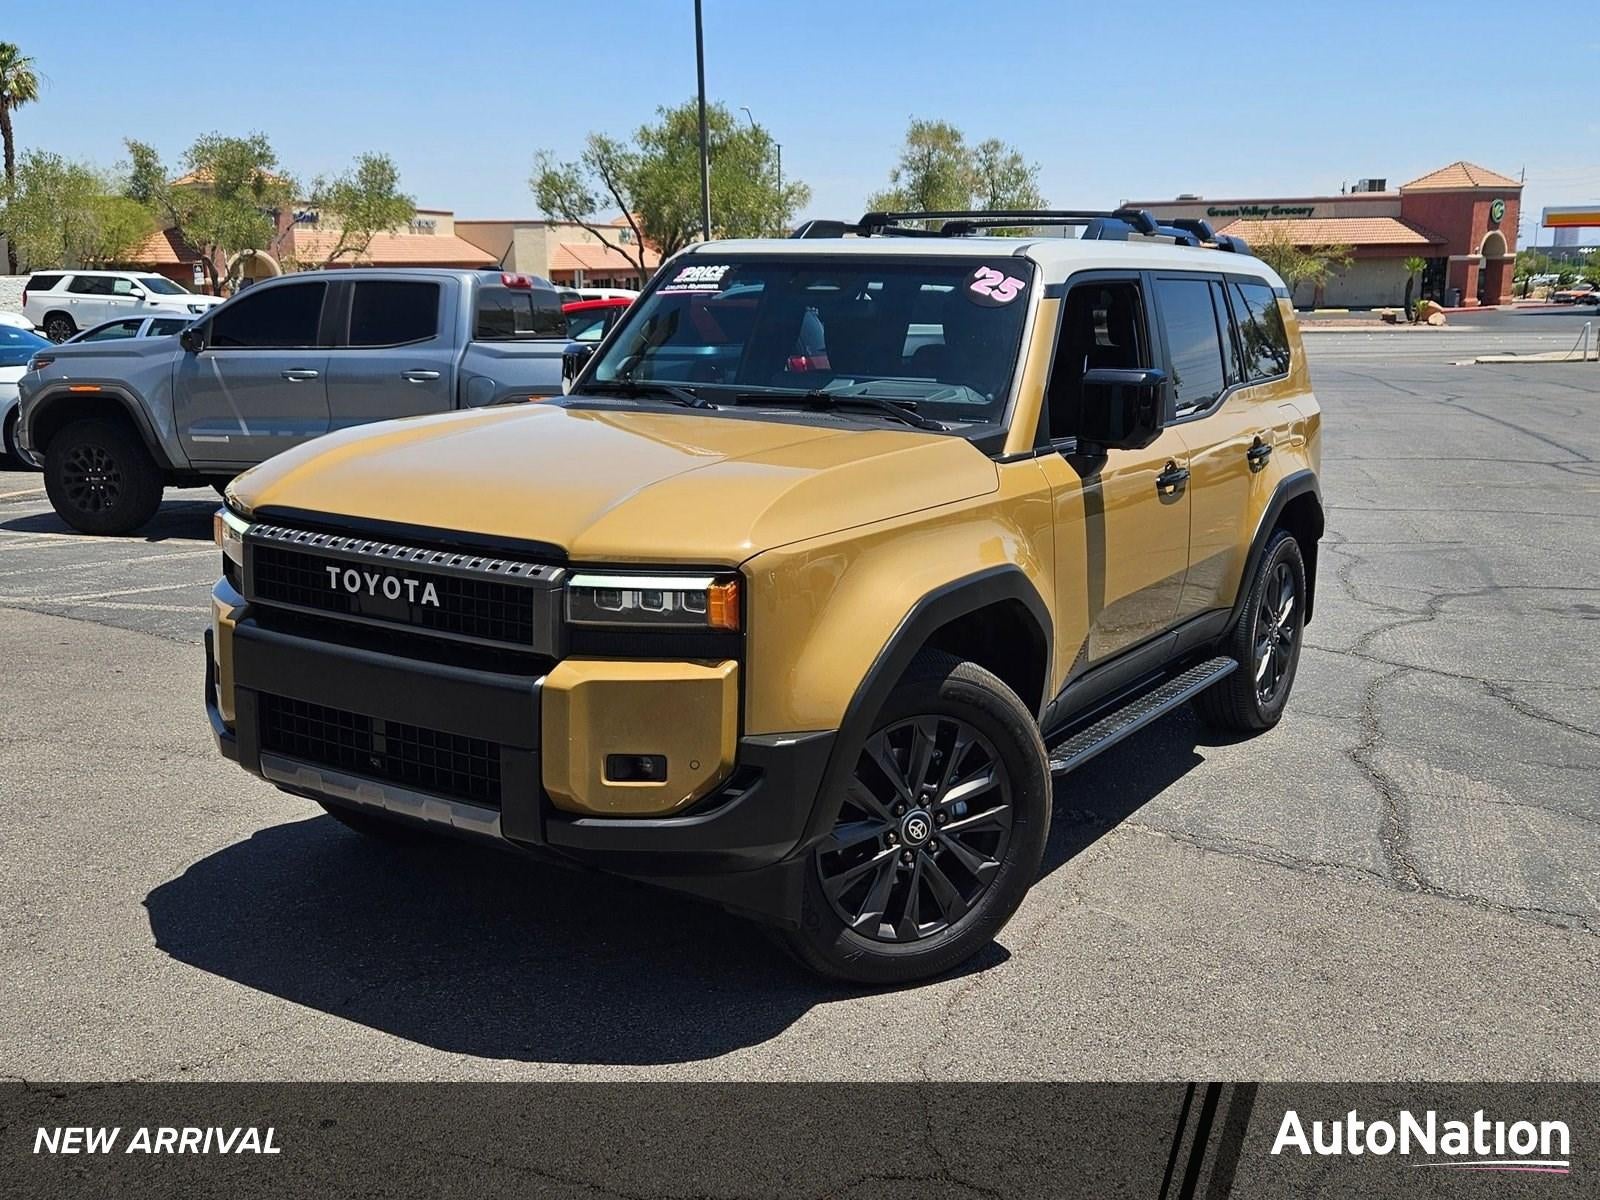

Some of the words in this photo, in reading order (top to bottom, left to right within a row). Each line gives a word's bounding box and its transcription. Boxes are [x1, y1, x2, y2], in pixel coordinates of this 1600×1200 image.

[1207, 207, 1239, 217] Green
[1240, 206, 1270, 219] Valley
[1271, 205, 1315, 217] Grocery
[325, 565, 440, 607] TOYOTA
